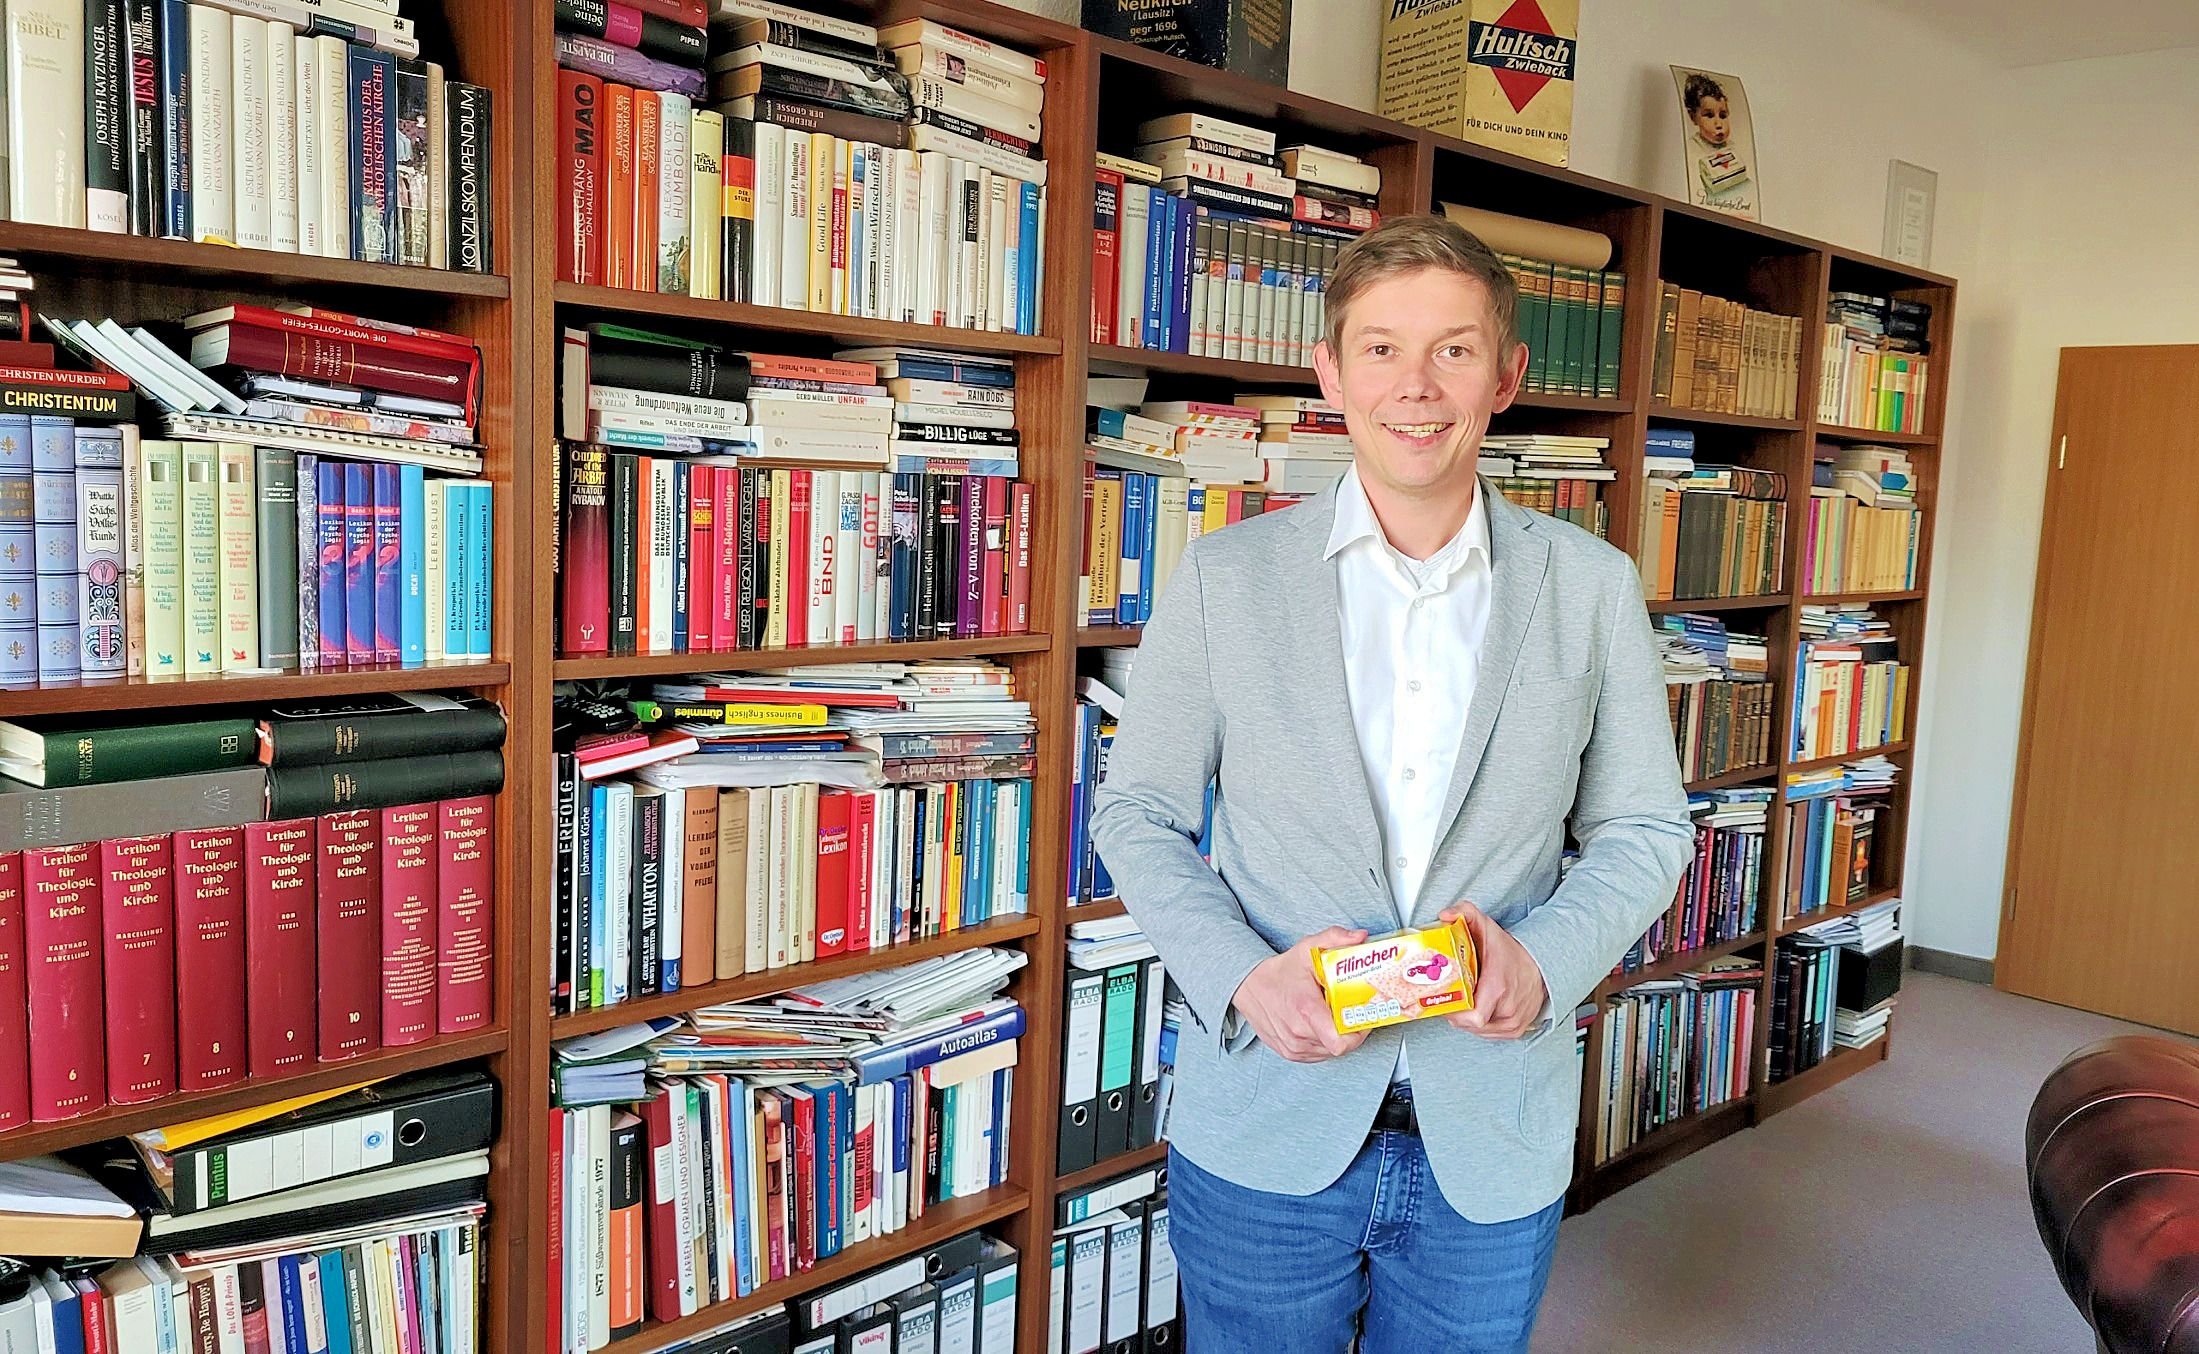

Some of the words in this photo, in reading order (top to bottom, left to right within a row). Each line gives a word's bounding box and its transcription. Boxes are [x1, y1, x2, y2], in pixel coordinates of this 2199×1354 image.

[574, 9, 604, 27] Seine
[1154, 20, 1177, 32] 1696
[107, 3, 118, 77] CHRISTENTUM
[1474, 25, 1570, 64] Hultsch
[93, 23, 108, 97] RATZINGER
[1504, 57, 1567, 78] Zwieback
[133, 54, 157, 107] JESUS
[303, 61, 312, 81] Welt
[109, 75, 118, 94] DAS
[303, 80, 312, 95] der
[361, 79, 373, 107] DER
[372, 64, 384, 114] KIRCHE
[110, 94, 119, 107] IN
[303, 95, 312, 115] Licht
[615, 94, 623, 112] DES
[775, 102, 807, 116] GROSSE
[95, 95, 110, 146] JOSEPH
[212, 88, 223, 141] NAZARETH
[254, 96, 264, 149] NAZARETH
[573, 83, 594, 156] MAO
[775, 113, 818, 129] FRIEDRICH
[809, 108, 824, 119] DER
[615, 113, 624, 157] KLASSIKER
[663, 119, 672, 146] VON
[1466, 117, 1481, 129] FÜR
[1483, 121, 1503, 133] DICH
[1504, 124, 1523, 135] UND
[1525, 128, 1545, 139] DEIN
[1547, 130, 1568, 142] KIND
[255, 148, 264, 172] VON
[362, 107, 374, 196] KATECHISMUS
[286, 153, 296, 178] VON
[373, 114, 385, 214] KATHOLISCHEN
[672, 120, 685, 219] HUMBOLDT
[460, 88, 477, 268] KONZILSKOMPENDIUM
[573, 158, 585, 209] CHANG
[663, 148, 672, 217] ALEXANDER
[585, 168, 594, 216] HALLIDAY
[868, 161, 881, 227] Wirtschaft?
[789, 190, 800, 218] Samuel
[815, 201, 827, 223] Life
[176, 204, 185, 230] HERDER
[307, 222, 315, 247] HERDER
[815, 224, 828, 253] Good
[869, 227, 878, 238] ist
[869, 238, 879, 258] Was
[1152, 220, 1161, 274] Kaufmannswissen
[1009, 249, 1018, 281] KÖHLER
[1009, 282, 1017, 309] HORST
[1150, 276, 1159, 312] Praktisches
[281, 317, 370, 341] WORT-GOTTES-FEIER
[372, 332, 388, 344] DIE
[56, 373, 107, 385] WURDEN
[4, 390, 118, 414] CHRISTENTUM
[634, 394, 692, 417] Weltunordnung
[837, 395, 869, 406] UNFAIR!
[966, 389, 985, 401] RAIN
[986, 390, 1006, 403] DOGS
[693, 403, 712, 417] neue
[712, 407, 725, 419] Die
[665, 419, 678, 427] DAS
[679, 421, 696, 429] ENDE
[696, 422, 710, 430] DER
[710, 423, 732, 432] ARBEIT
[924, 424, 968, 442] BILLIG
[131, 464, 143, 523] Weltgeschichte
[741, 477, 753, 516] ENGELS
[659, 478, 667, 541] BUNDESREPUBLIK
[722, 484, 735, 547] Reformlüge
[968, 481, 983, 546] Anekdoten
[1099, 487, 1110, 530] Verträge
[131, 522, 139, 535] der
[428, 491, 439, 570] LEBENSLUST
[862, 492, 879, 550] GOTT
[925, 519, 935, 537] Mein
[131, 534, 140, 554] Atlas
[741, 519, 752, 550] MARX
[1098, 532, 1106, 549] der
[722, 547, 733, 565] Die
[820, 534, 834, 597] BND
[921, 550, 934, 574] Kohl
[968, 549, 980, 571] von
[1017, 544, 1029, 568] Das
[1096, 551, 1105, 604] Handbuch
[676, 591, 687, 614] Alfred
[812, 577, 821, 608] DER
[921, 576, 934, 613] Helmut
[1089, 588, 1097, 604] Das
[728, 708, 764, 720] Englisch
[765, 711, 803, 721] Business
[392, 810, 429, 824] Lexikon
[448, 805, 484, 819] Lexikon
[558, 780, 575, 855] ERFOLG
[578, 806, 591, 837] Küche
[331, 818, 370, 832] Lexikon
[404, 822, 420, 834] für
[190, 835, 233, 850] Lexikon
[265, 828, 307, 843] Lexikon
[387, 832, 434, 847] Theologie
[115, 842, 161, 856] Lexikon
[204, 849, 221, 861] für
[402, 845, 422, 857] und
[453, 849, 482, 863] Kirche
[579, 838, 592, 877] Johanns
[819, 840, 848, 856] Lexikon
[42, 853, 88, 868] Lexikon
[397, 856, 427, 870] Kirche
[58, 867, 76, 878] für
[336, 865, 368, 879] Kirche
[36, 877, 97, 894] Theologie
[196, 885, 231, 900] Kirche
[271, 877, 304, 891] Kirche
[55, 892, 79, 904] und
[123, 893, 159, 907] Kirche
[642, 861, 658, 931] WHARTON
[49, 904, 86, 919] Kirche
[581, 935, 589, 978] JOHANN
[1335, 945, 1399, 977] Filinchen
[1109, 974, 1135, 988] ELBA
[1109, 983, 1135, 996] RADO
[1073, 985, 1100, 999] ELBA
[1073, 995, 1099, 1007] RADO
[1425, 993, 1452, 1006] Original
[348, 1011, 361, 1024] 10
[285, 1030, 294, 1042] 9
[939, 1028, 998, 1057] Autoatlas
[212, 1042, 221, 1055] 8
[143, 1053, 151, 1066] 7
[68, 1068, 78, 1081] 6
[676, 1113, 690, 1166] DESIGNER
[211, 1152, 225, 1200] Printus
[550, 1150, 560, 1207] TEEKANNE
[678, 1168, 690, 1190] UND
[679, 1191, 692, 1237] FORMEN
[1112, 1227, 1141, 1242] ELBA
[1112, 1235, 1140, 1249] RADO
[1074, 1238, 1103, 1254] ELBA
[1074, 1248, 1102, 1261] RADO
[680, 1239, 693, 1279] FARBEN,
[196, 1282, 211, 1317] Happy!
[943, 1300, 972, 1317] RADO
[200, 1318, 211, 1332] Be
[227, 1322, 237, 1335] Das
[902, 1323, 932, 1340] RADO
[858, 1331, 886, 1346] Viking
